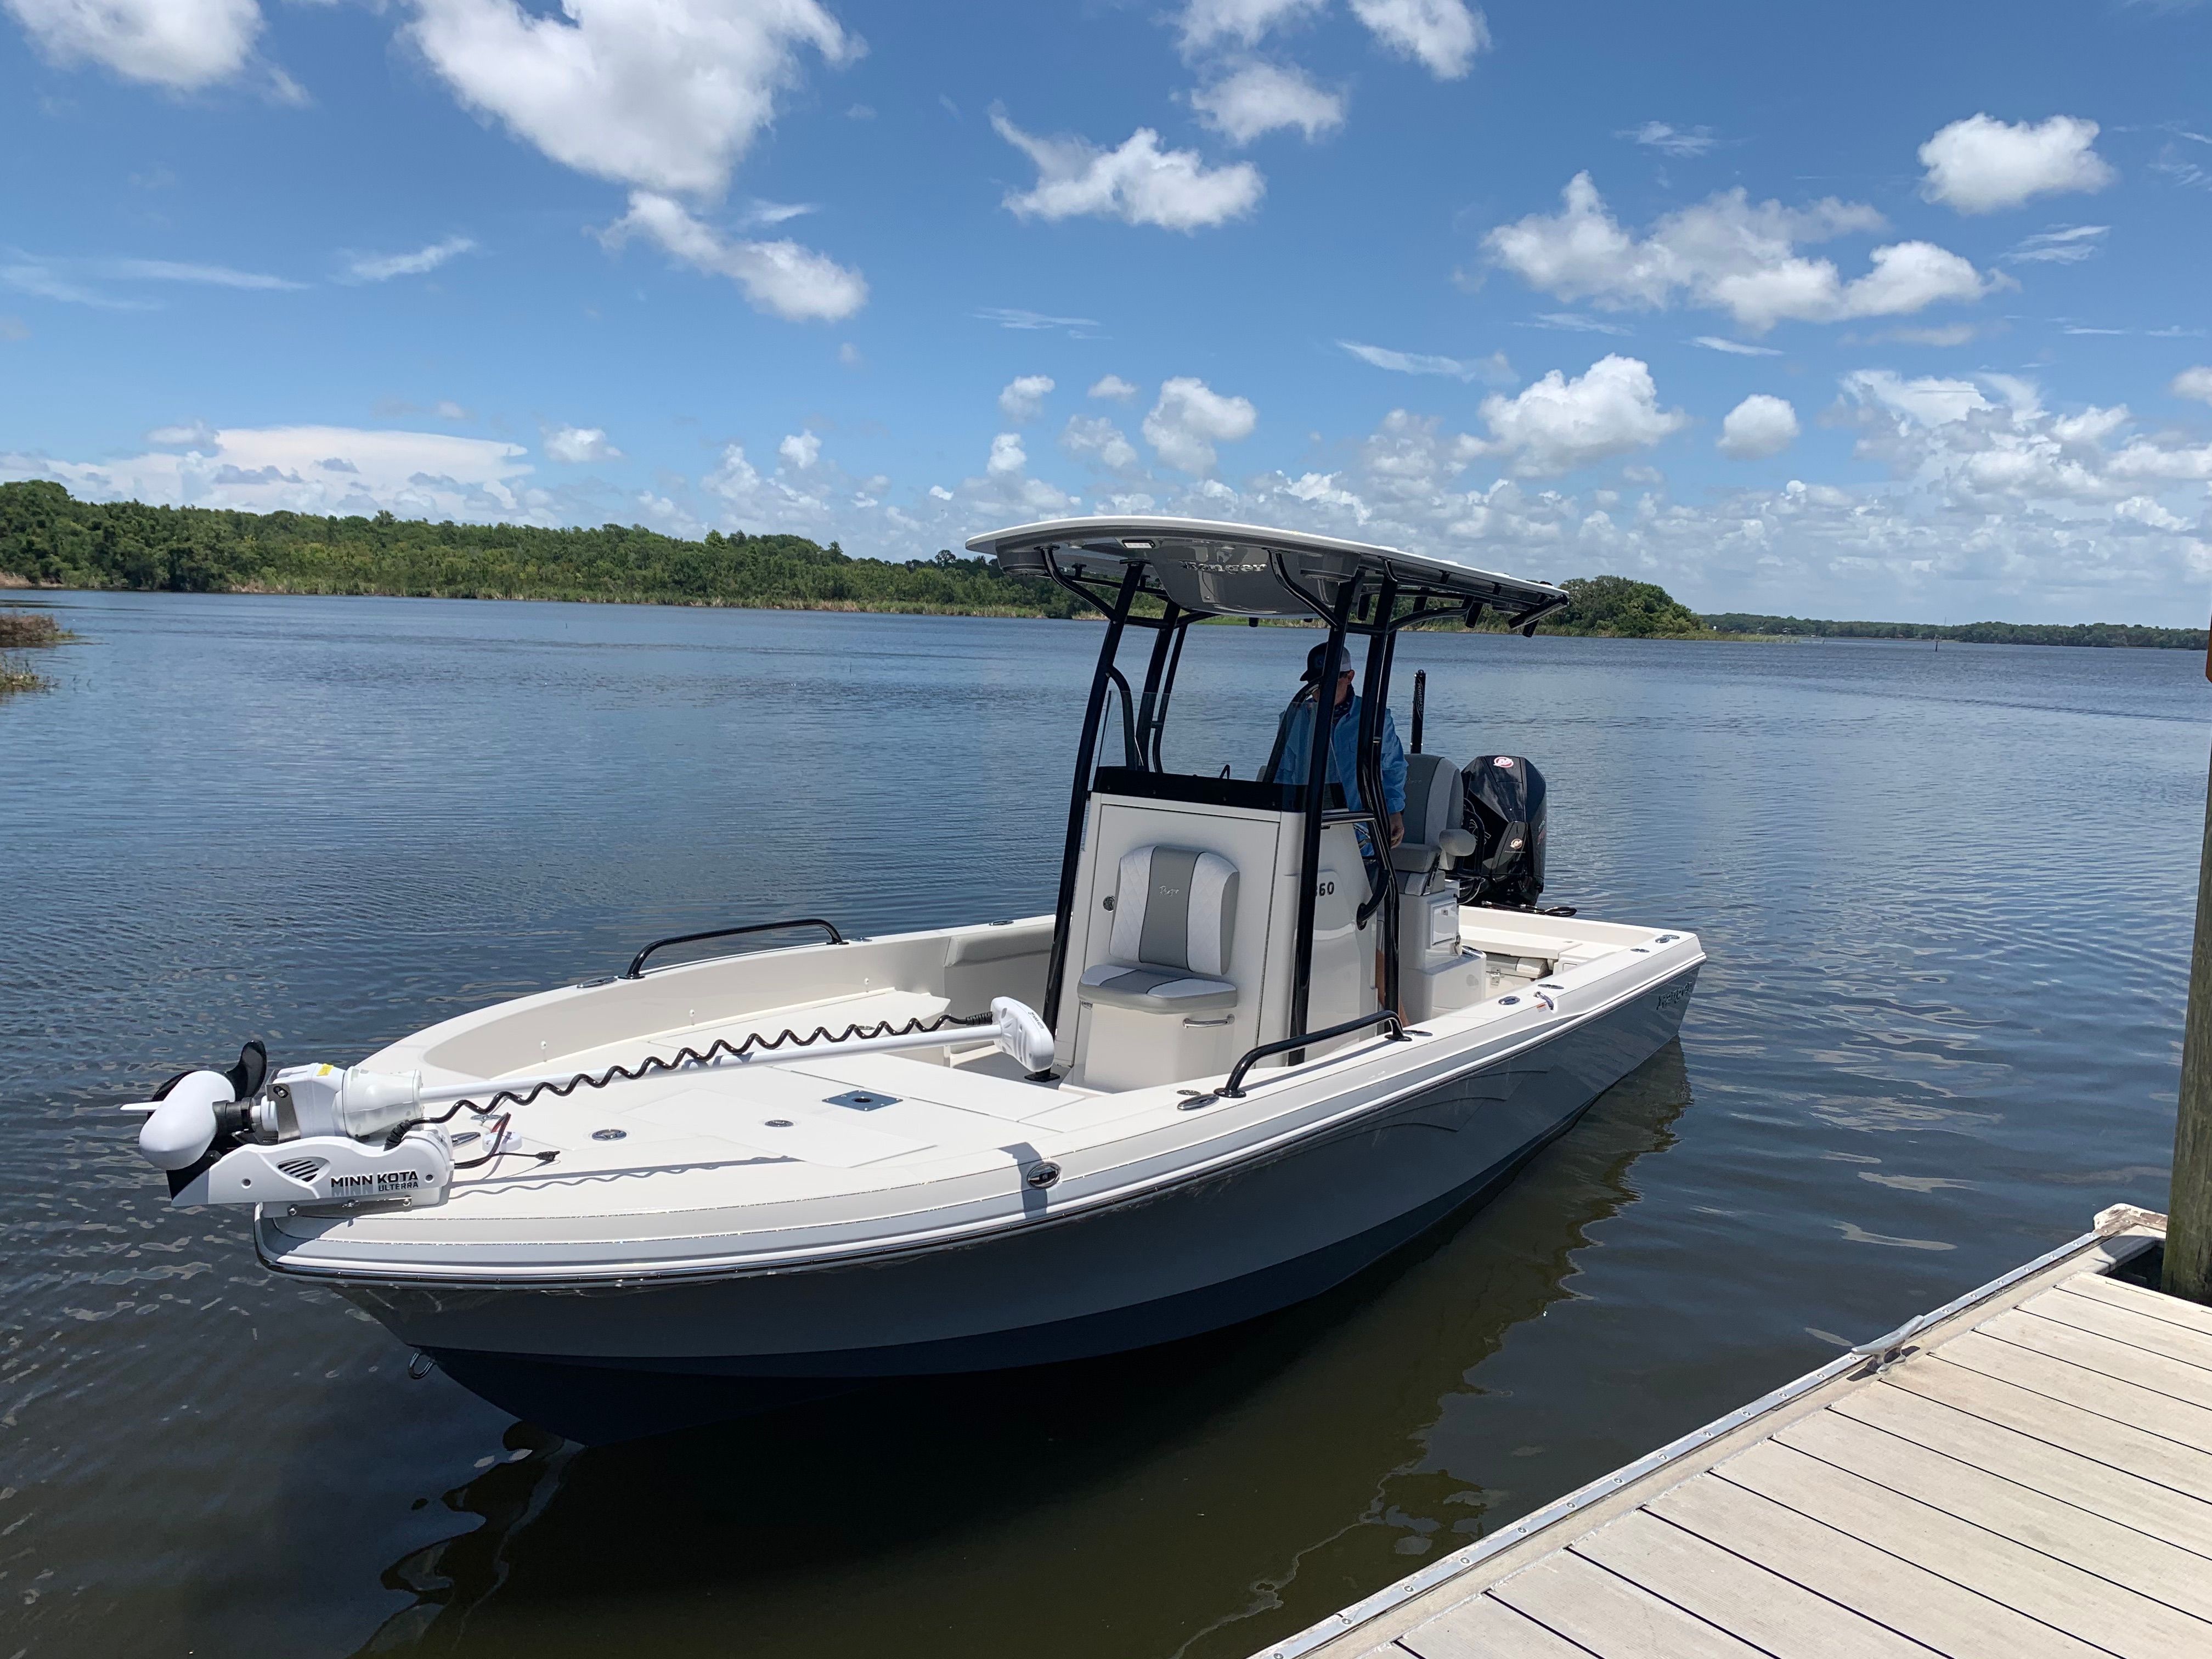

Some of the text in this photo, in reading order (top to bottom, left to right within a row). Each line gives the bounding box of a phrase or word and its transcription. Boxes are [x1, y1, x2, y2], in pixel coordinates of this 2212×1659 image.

[1179, 561, 1267, 574] Ranger
[1316, 881, 1335, 897] 60
[331, 1171, 419, 1188] MINN KOTA
[379, 1182, 419, 1192] ULTERRA
